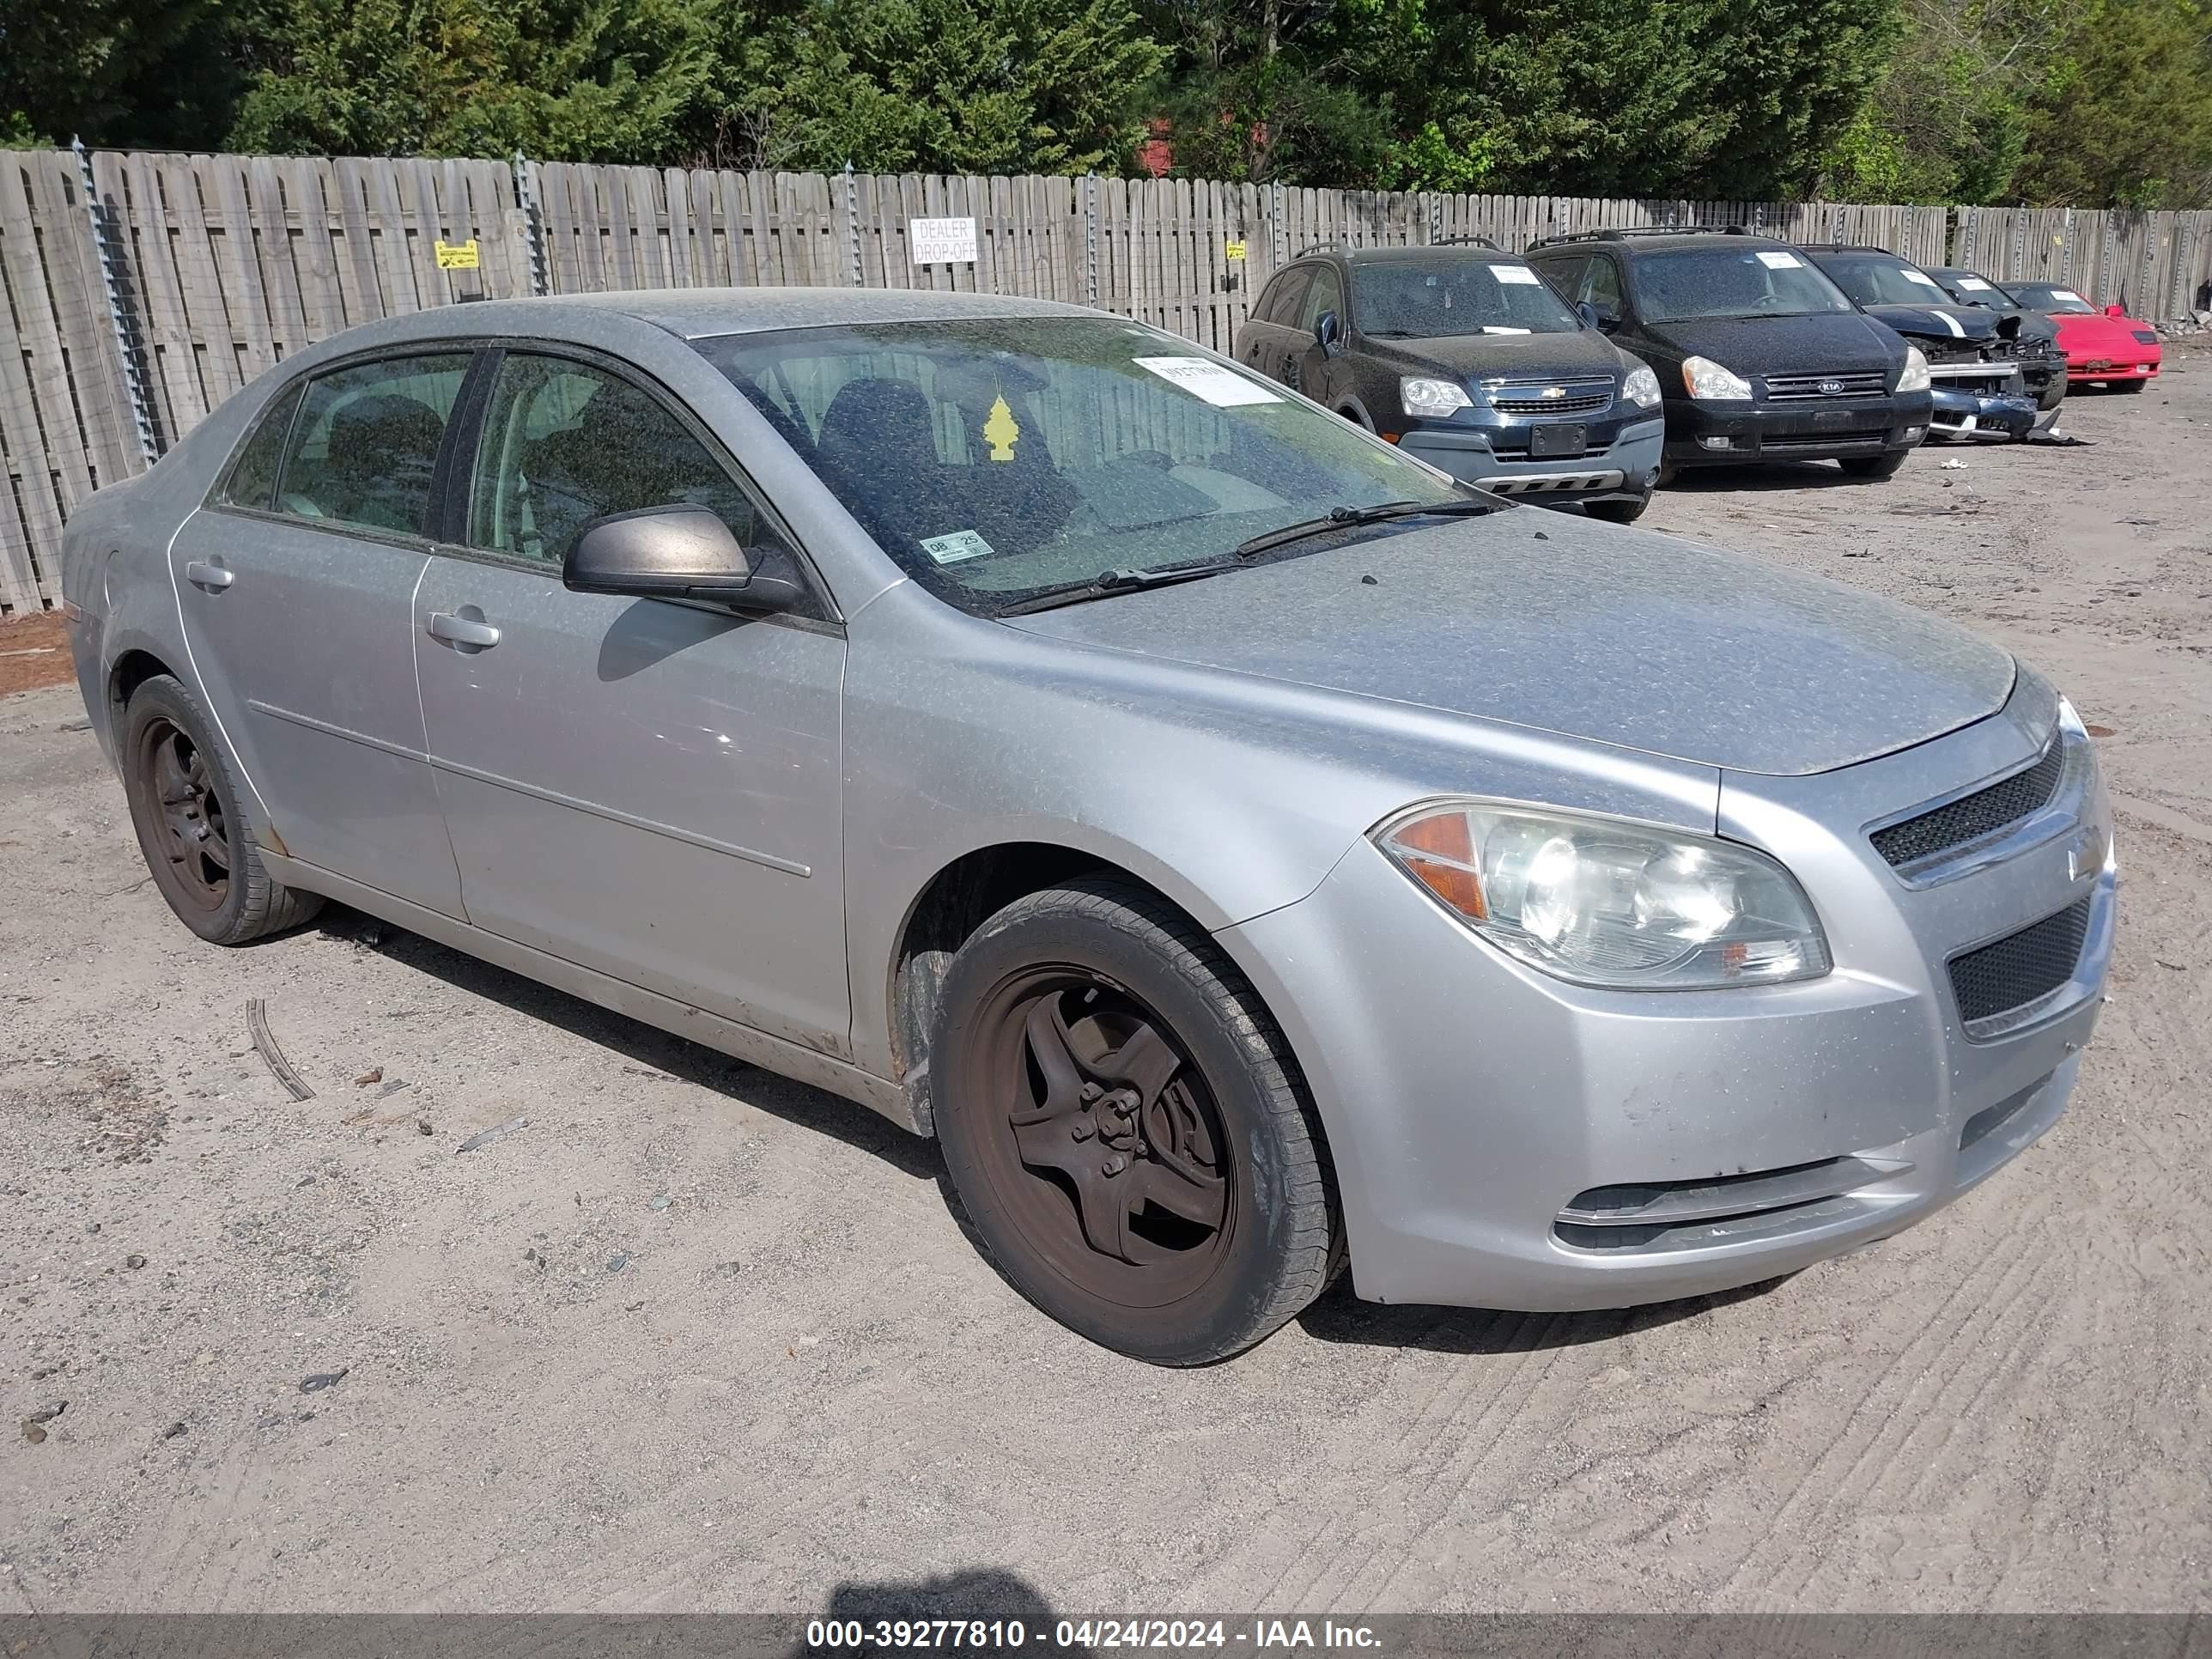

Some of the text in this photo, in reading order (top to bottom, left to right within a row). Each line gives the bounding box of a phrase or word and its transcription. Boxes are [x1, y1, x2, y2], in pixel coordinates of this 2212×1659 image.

[920, 220, 968, 240] DEALER
[915, 241, 975, 262] DROP-OFF
[929, 535, 978, 552] 08 25
